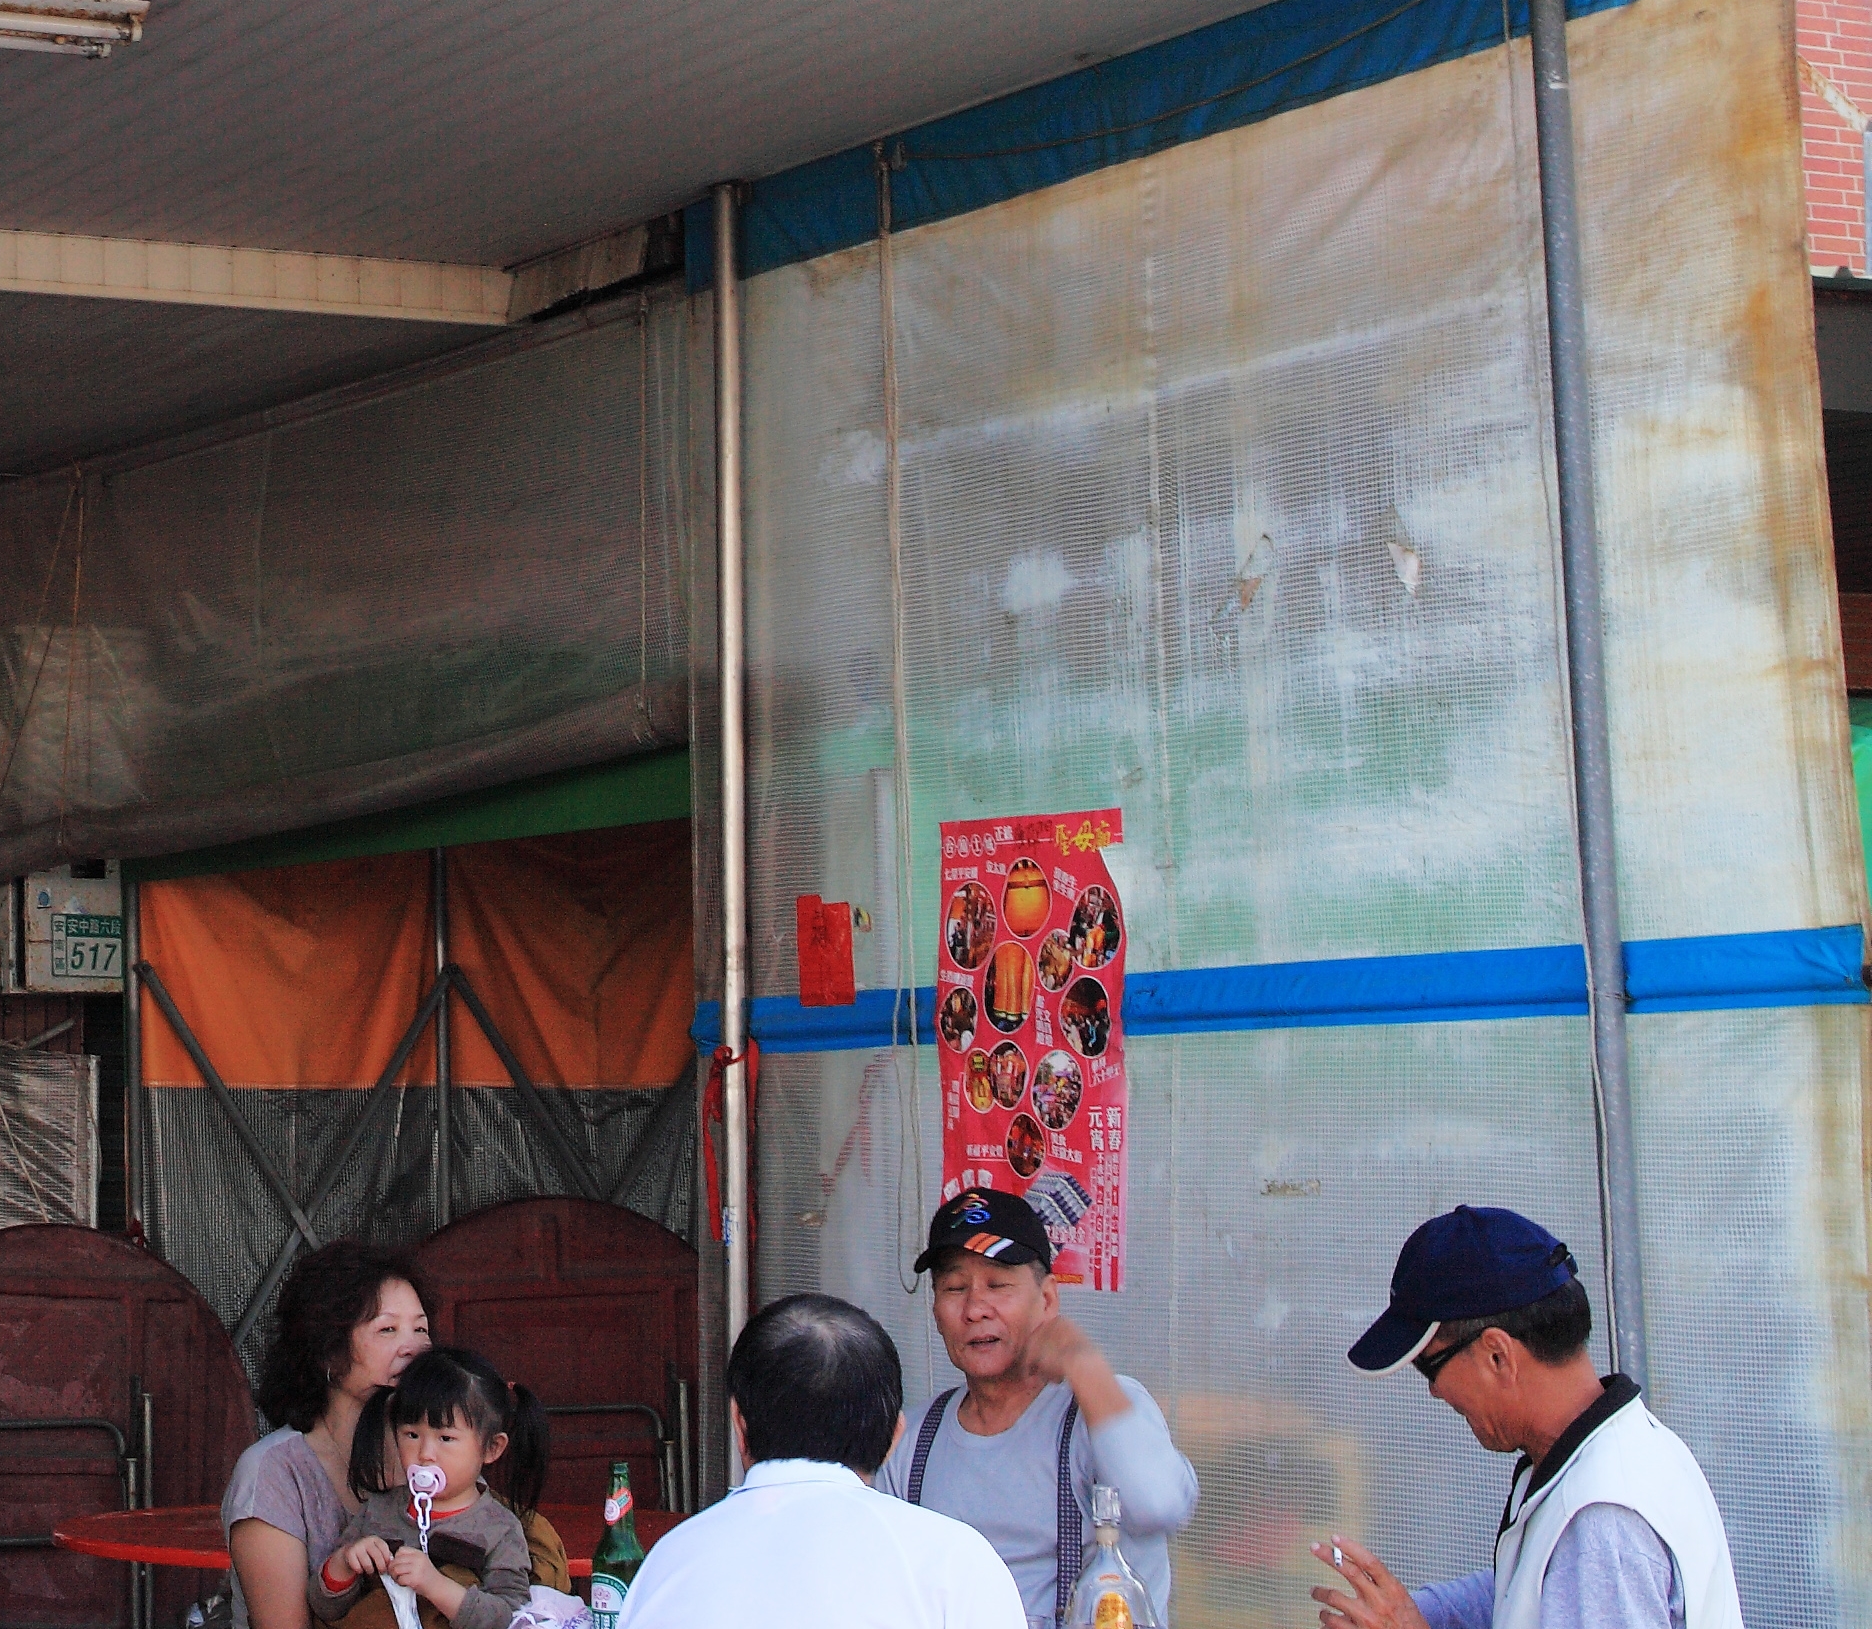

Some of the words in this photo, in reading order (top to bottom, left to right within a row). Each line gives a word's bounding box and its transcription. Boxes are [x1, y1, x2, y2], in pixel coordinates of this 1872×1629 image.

[68, 918, 121, 934] 安中路六段
[71, 942, 117, 970] 517
